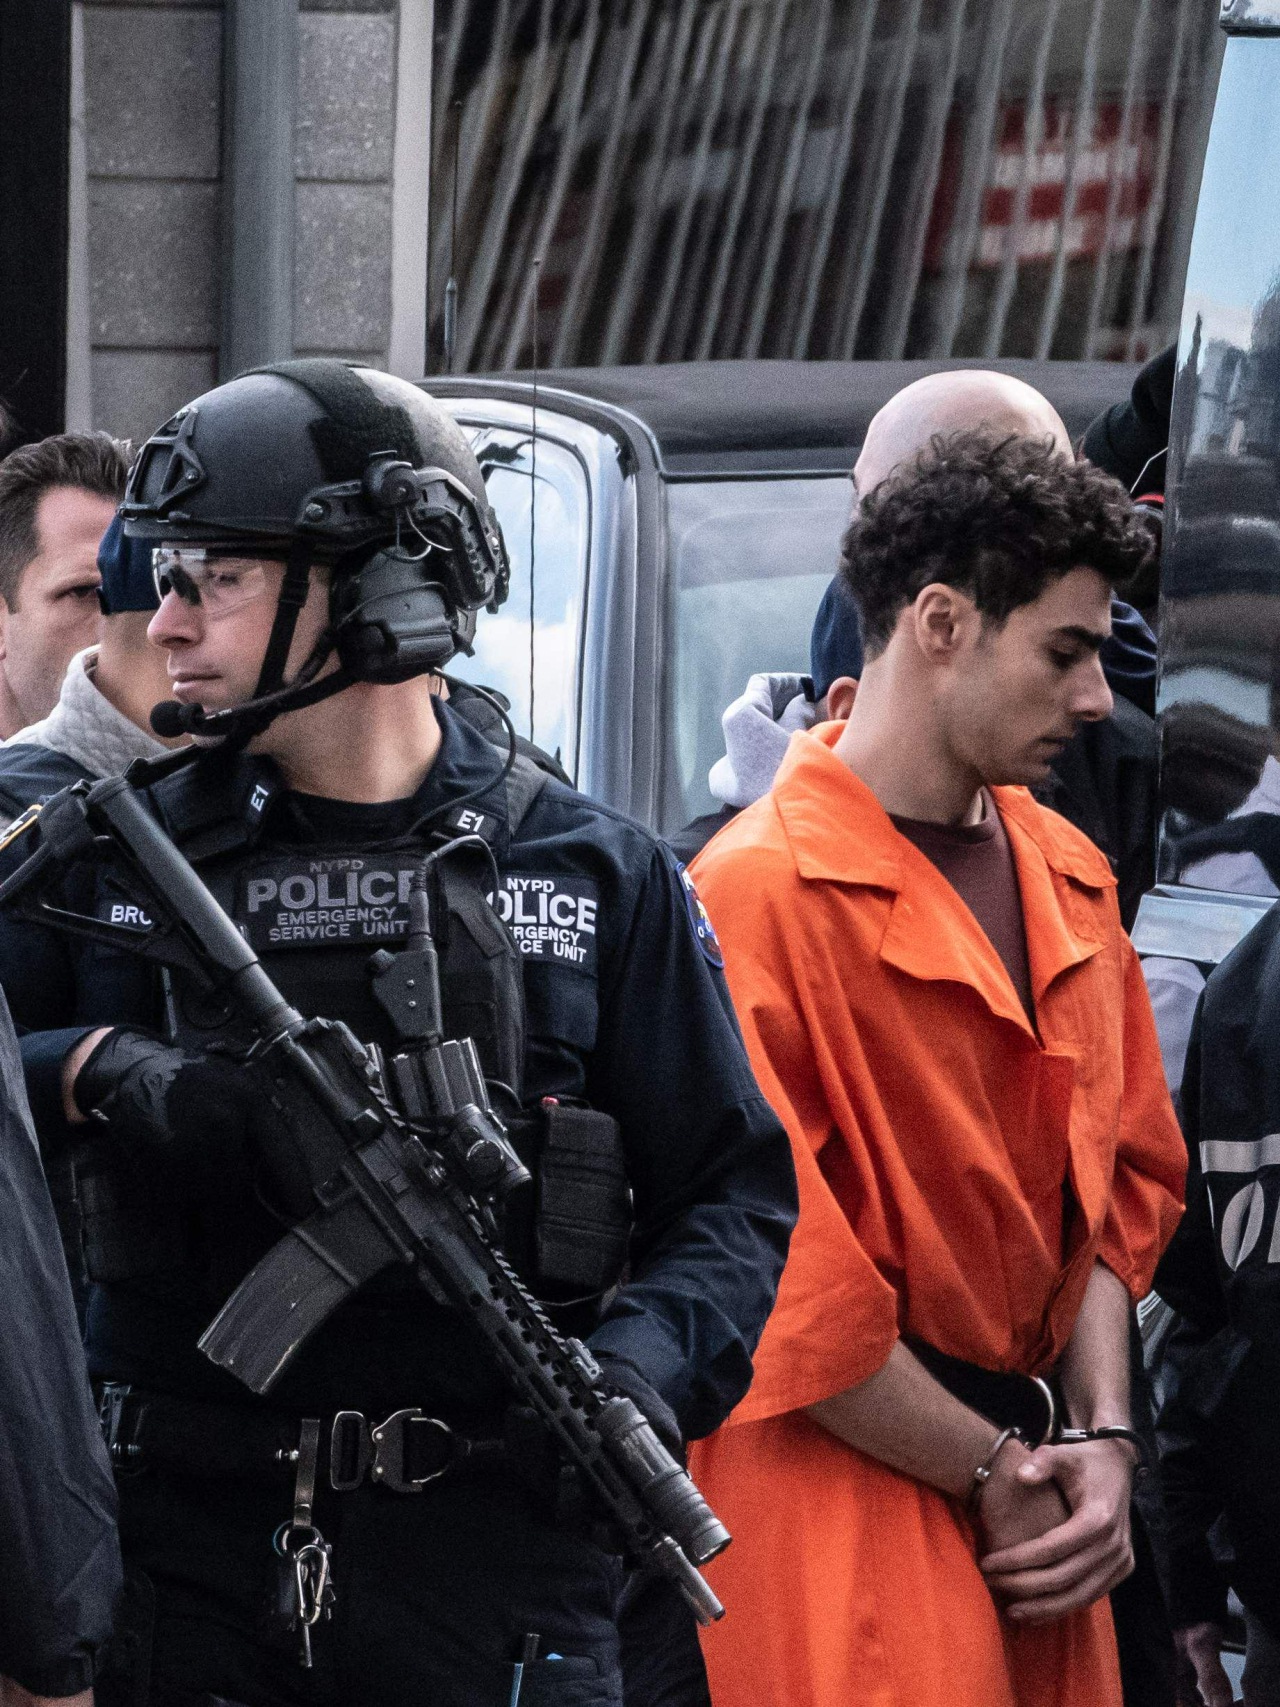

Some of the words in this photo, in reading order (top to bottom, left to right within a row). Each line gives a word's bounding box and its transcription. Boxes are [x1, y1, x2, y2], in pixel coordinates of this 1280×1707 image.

[250, 784, 270, 812] E1
[456, 809, 485, 832] E1
[309, 859, 364, 873] NYPD
[506, 878, 555, 893] NYPD
[276, 906, 397, 926] EMERGENCY
[486, 889, 597, 935] OLICE
[268, 923, 351, 942] SERVICE
[362, 920, 409, 936] UNIT
[508, 926, 580, 946] RGENCY
[553, 942, 587, 963] UNIT
